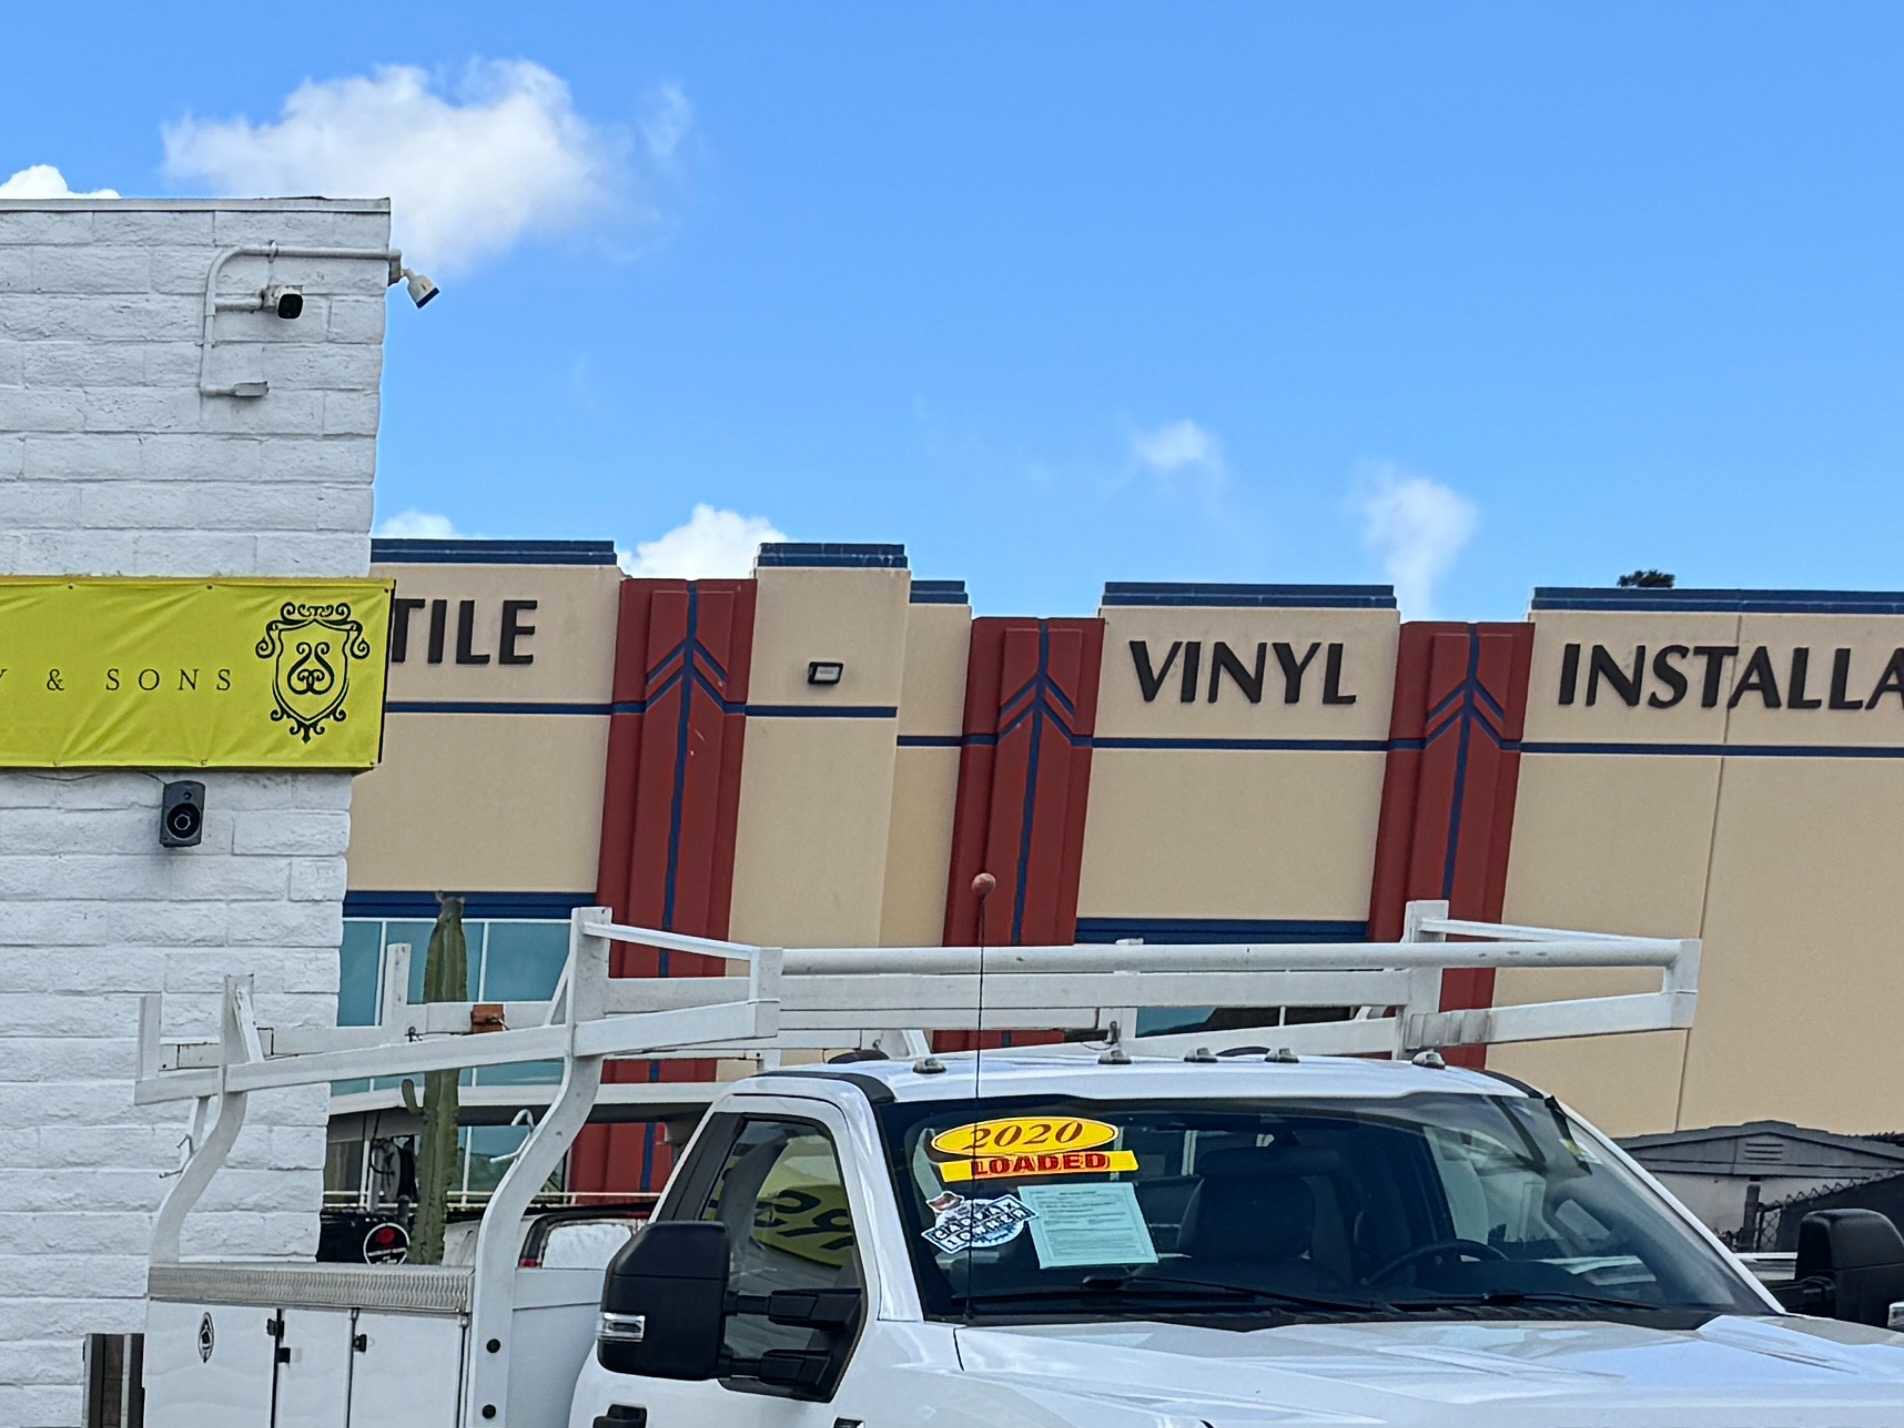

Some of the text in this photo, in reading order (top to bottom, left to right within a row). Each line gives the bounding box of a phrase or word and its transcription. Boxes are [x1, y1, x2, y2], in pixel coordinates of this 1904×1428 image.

[392, 599, 538, 665] TILE
[45, 668, 66, 693] &
[105, 668, 234, 693] SONS
[1129, 639, 1358, 705] VINYL
[1558, 642, 1904, 711] INSTALLA
[962, 1119, 1083, 1150] 2020
[971, 1153, 1110, 1176] LOADED
